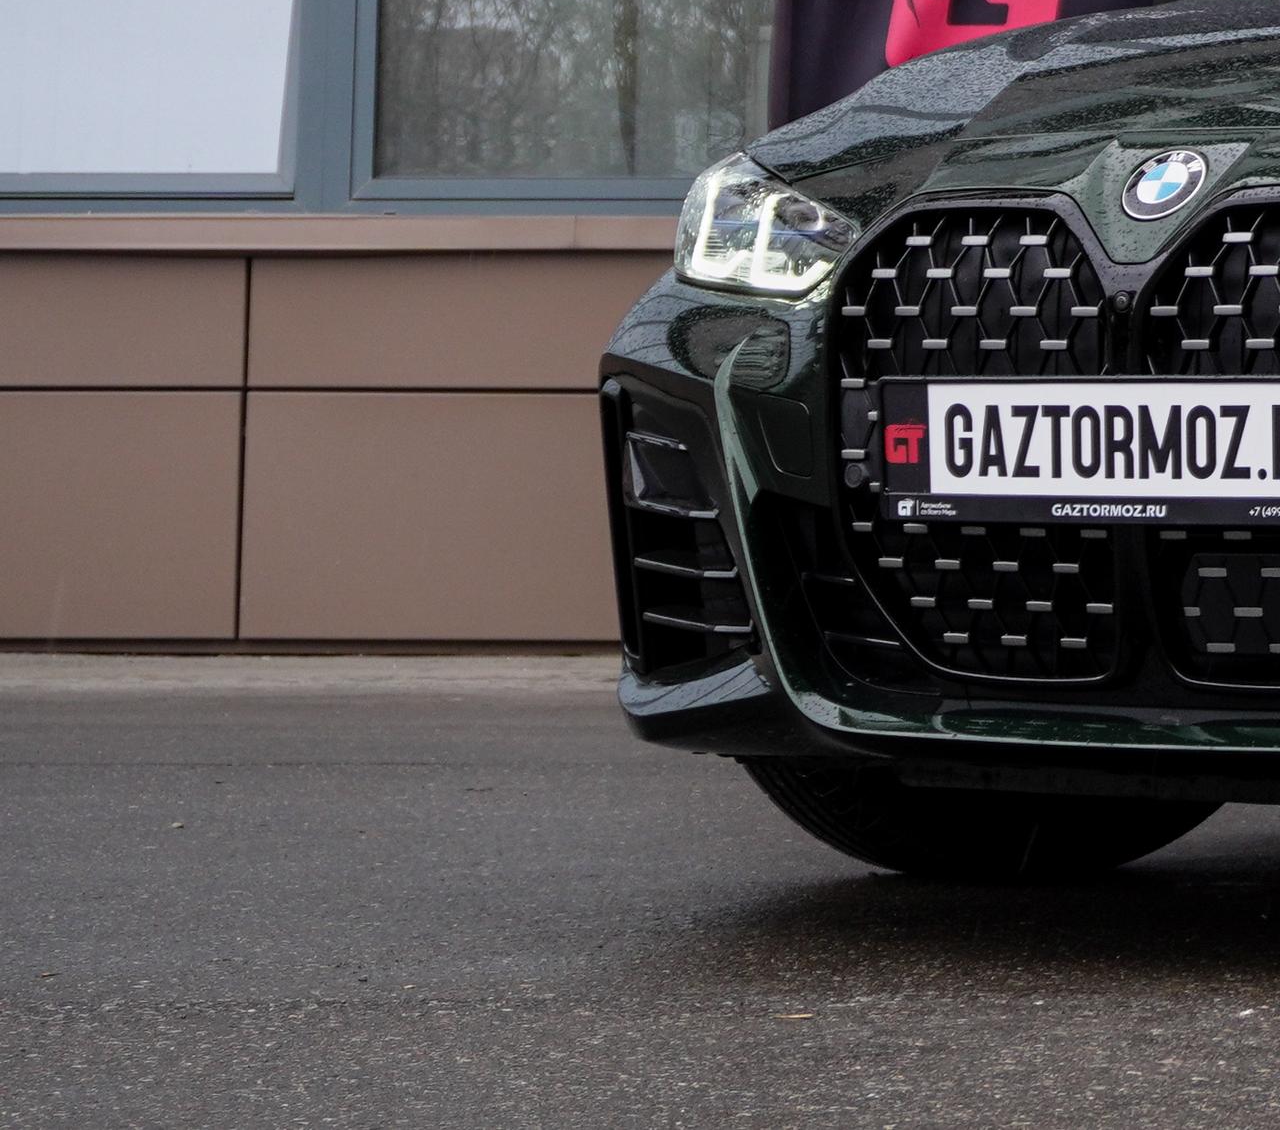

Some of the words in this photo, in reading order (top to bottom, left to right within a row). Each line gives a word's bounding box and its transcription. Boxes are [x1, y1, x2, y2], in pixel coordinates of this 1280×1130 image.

[885, 424, 926, 464] GT
[1051, 503, 1167, 518] GAZTORMOZ.RU
[1248, 506, 1261, 517] +7
